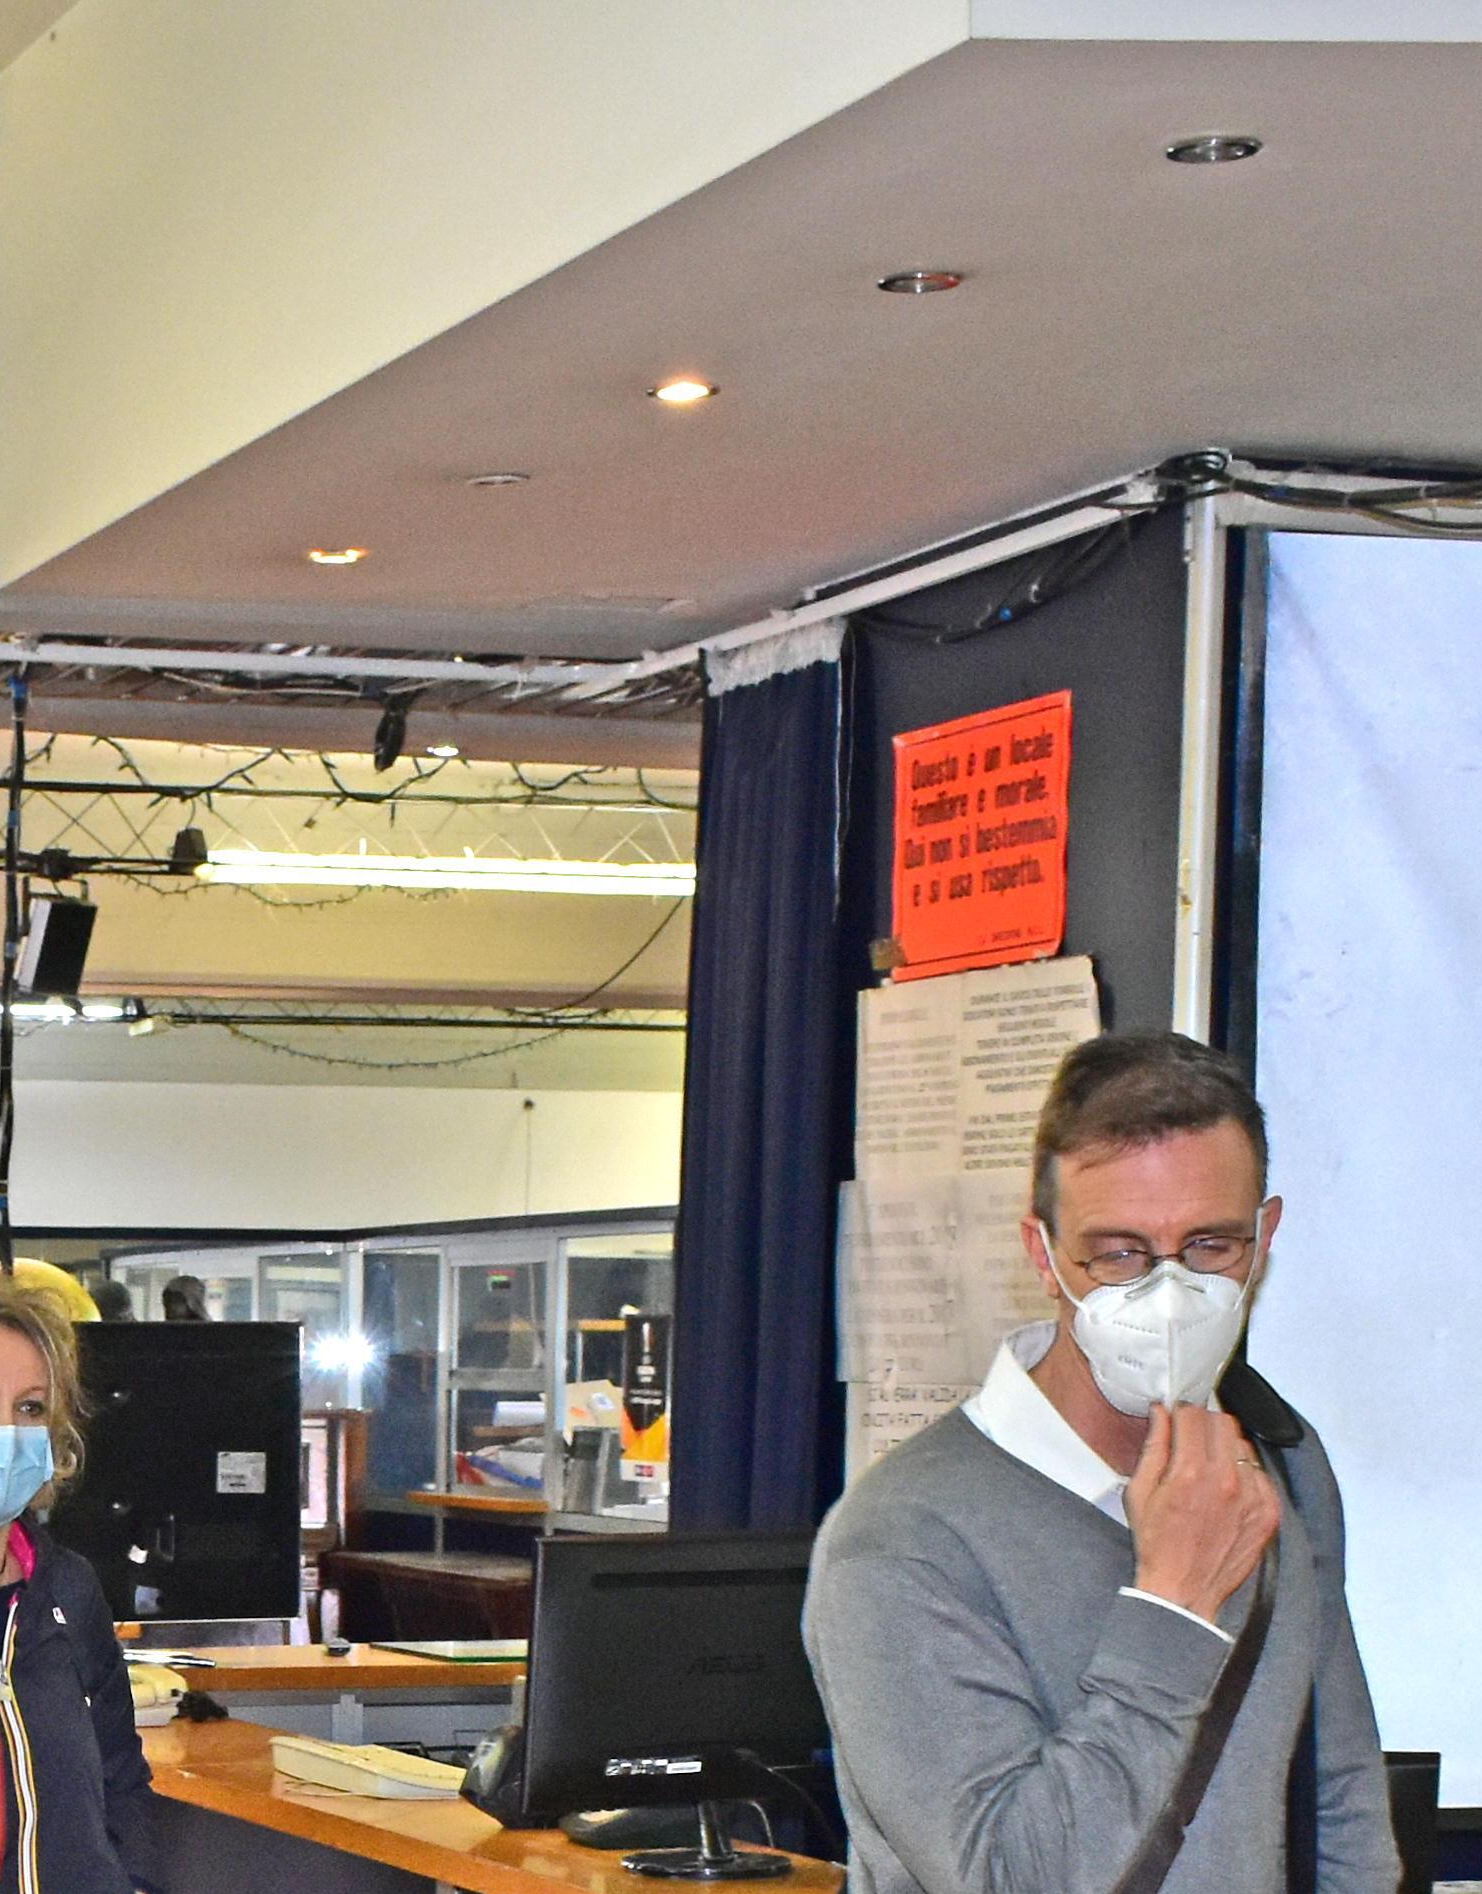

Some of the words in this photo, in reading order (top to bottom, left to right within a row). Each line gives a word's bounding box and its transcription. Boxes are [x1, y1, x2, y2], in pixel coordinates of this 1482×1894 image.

[984, 746, 1001, 773] un
[1010, 727, 1054, 765] locale
[977, 788, 986, 813] e
[930, 838, 953, 864] non
[913, 884, 921, 907] e
